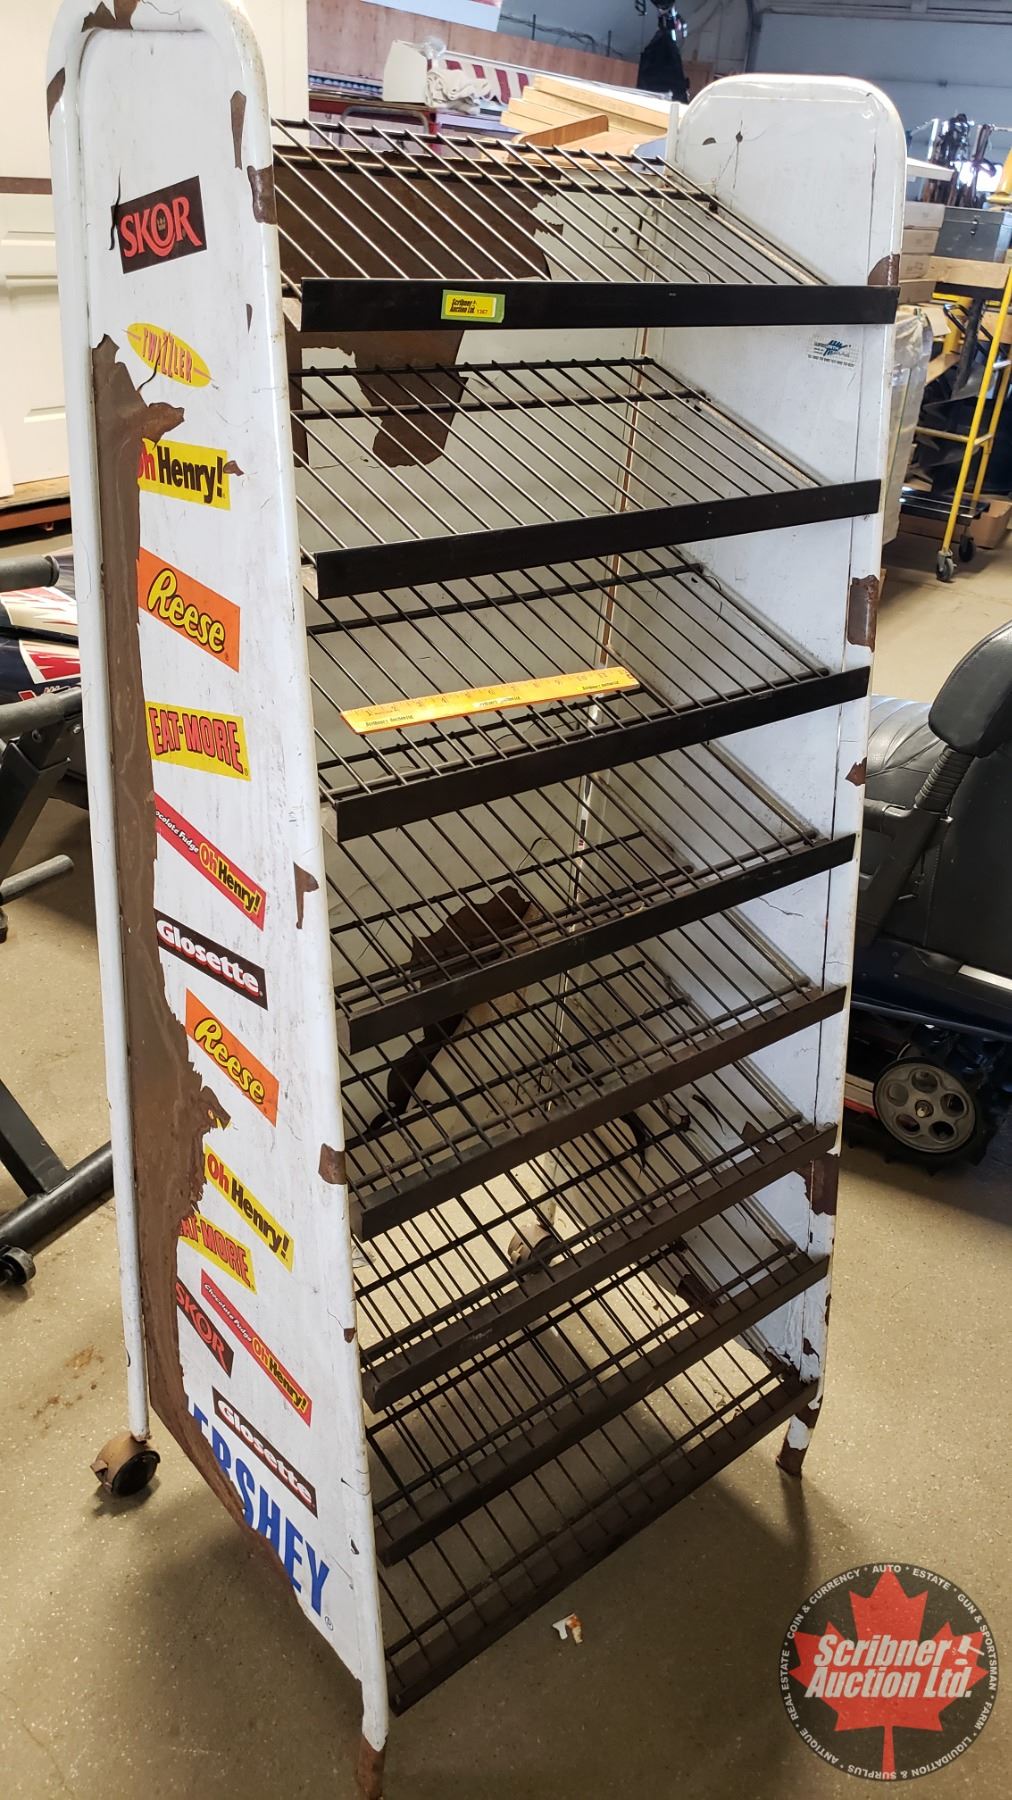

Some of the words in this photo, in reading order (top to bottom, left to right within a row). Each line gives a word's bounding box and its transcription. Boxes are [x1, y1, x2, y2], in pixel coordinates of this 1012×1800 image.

[120, 196, 203, 258] SKOR
[142, 327, 194, 384] TWIZZLER
[157, 446, 223, 504] Henry!
[147, 568, 225, 655] Reese
[148, 707, 244, 775] EAT-MORE
[178, 830, 200, 854] Fudge
[200, 843, 218, 876] Oh
[217, 857, 261, 913] Henry!
[156, 919, 260, 998] Glosette
[194, 1017, 265, 1105] Reese
[207, 1153, 229, 1194] Oh
[231, 1178, 289, 1260] Henry!
[178, 1215, 251, 1289] AT-MORE
[176, 1281, 228, 1373] SKOR
[204, 1283, 234, 1321] Chocolate
[233, 1318, 252, 1342] Fudge
[252, 1337, 269, 1369] Oh
[268, 1355, 308, 1412] Henry!
[217, 1400, 314, 1509] Glosette
